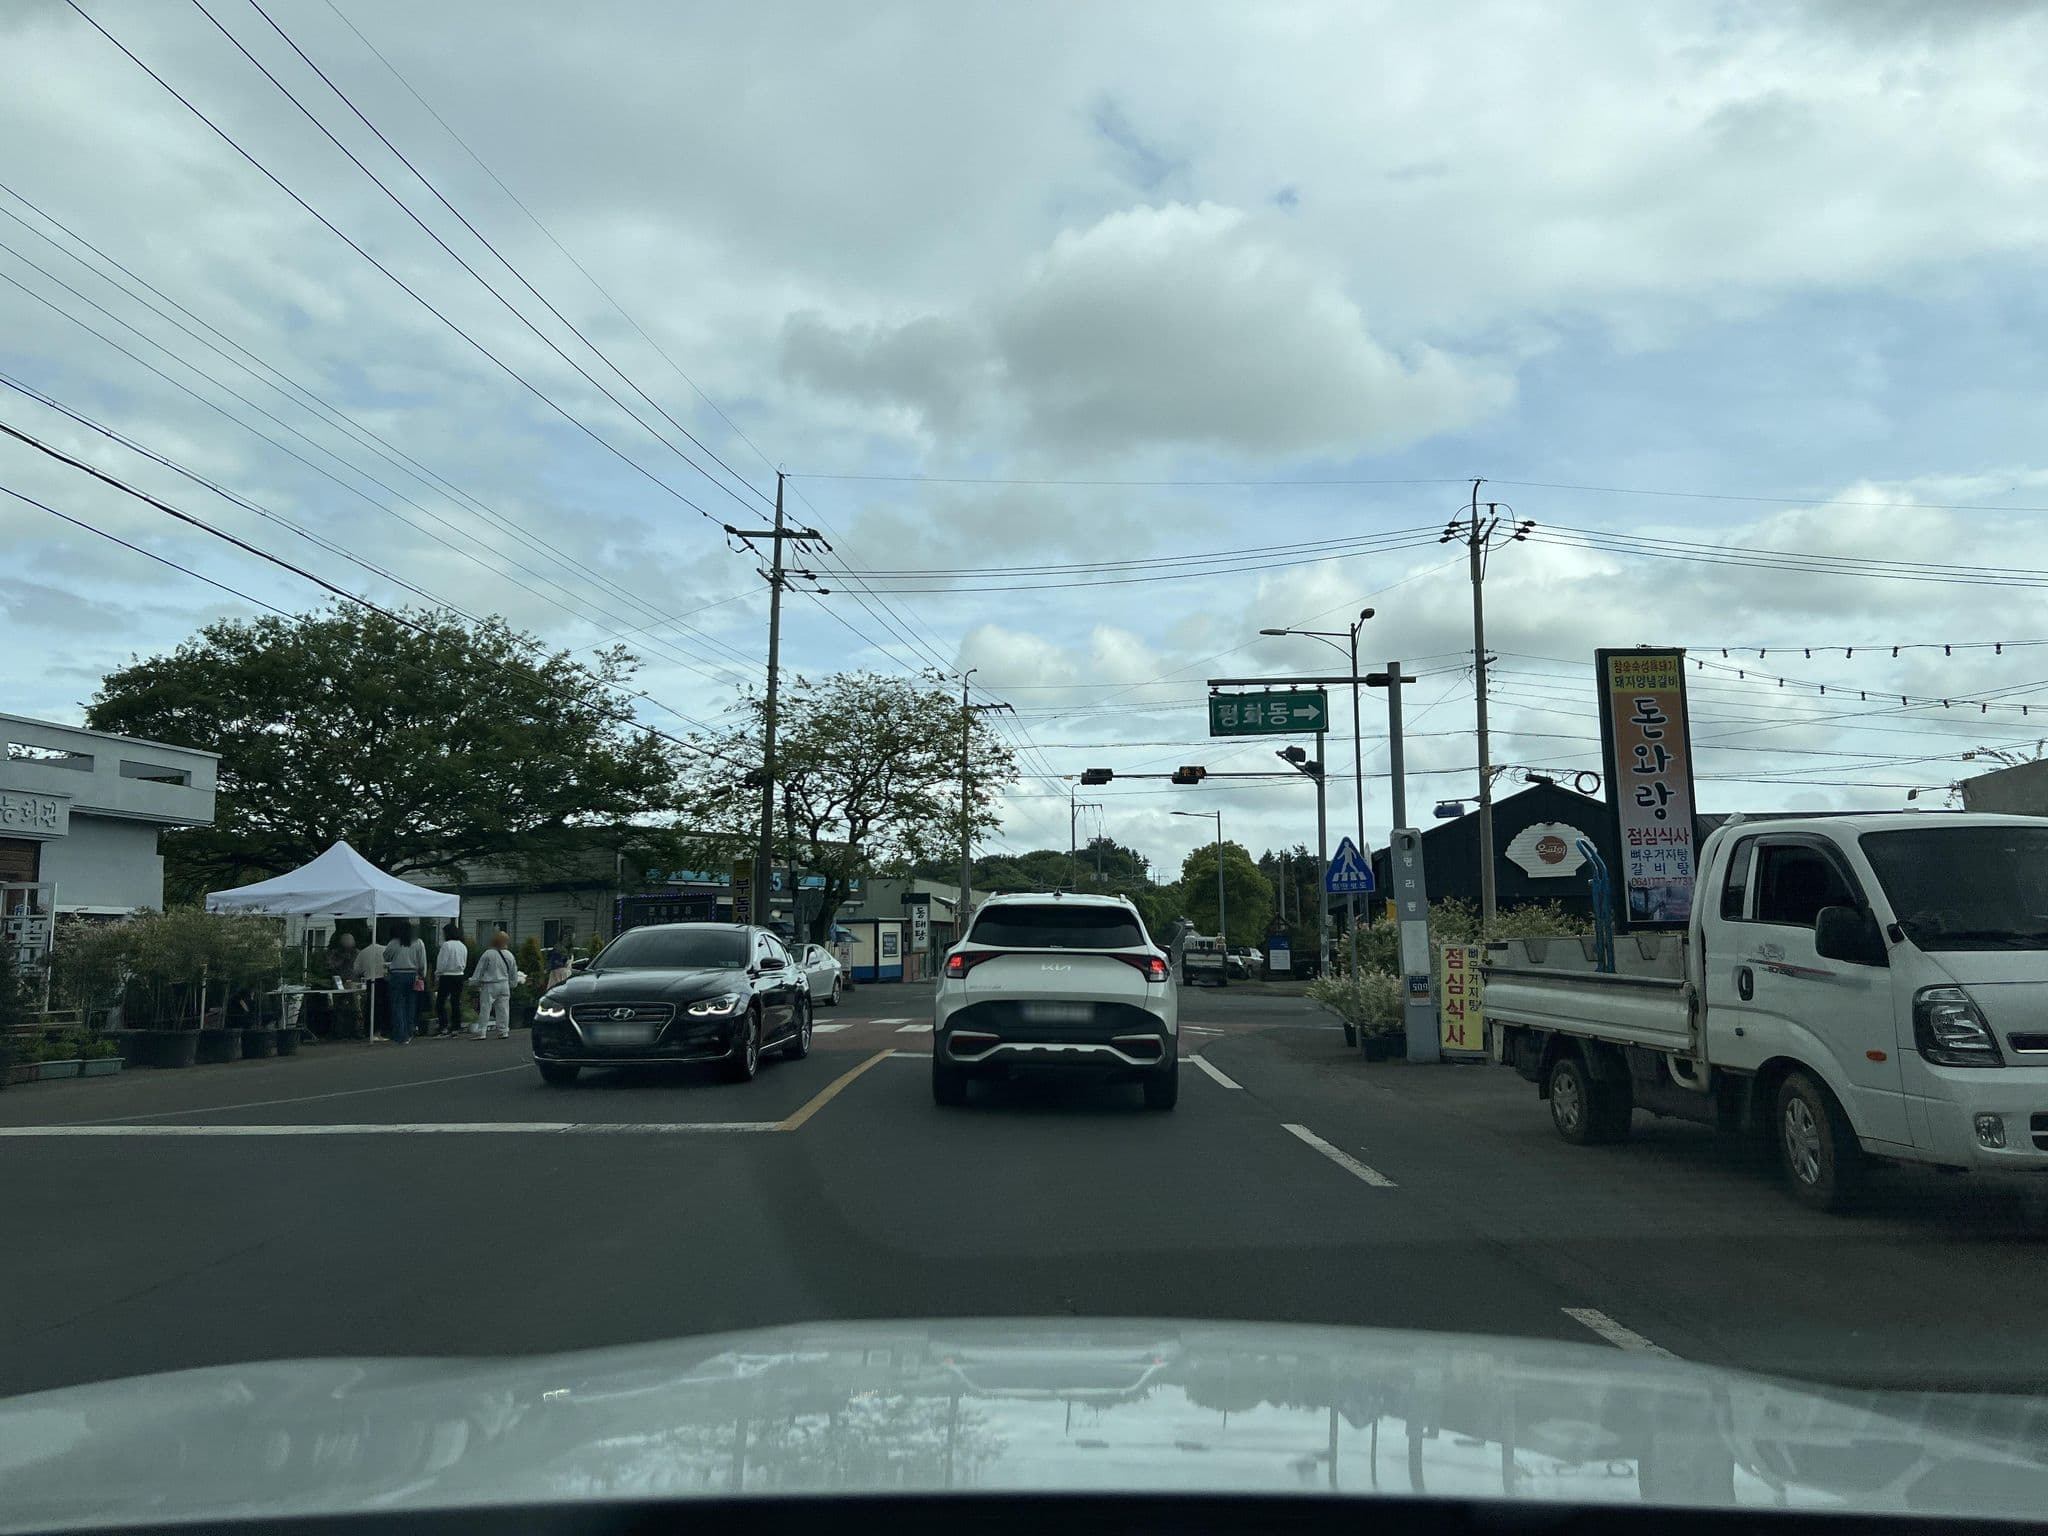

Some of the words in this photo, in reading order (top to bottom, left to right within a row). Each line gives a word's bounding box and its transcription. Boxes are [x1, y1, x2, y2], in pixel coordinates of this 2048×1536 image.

[1615, 675, 1678, 688] 돼지양념갈비
[1631, 695, 1676, 821] 돈와랑
[1627, 827, 1690, 846] 점심식사
[1630, 848, 1689, 862] 뼈우거지탕
[914, 907, 927, 941] 동태탕
[1445, 948, 1465, 1046] 점심식사
